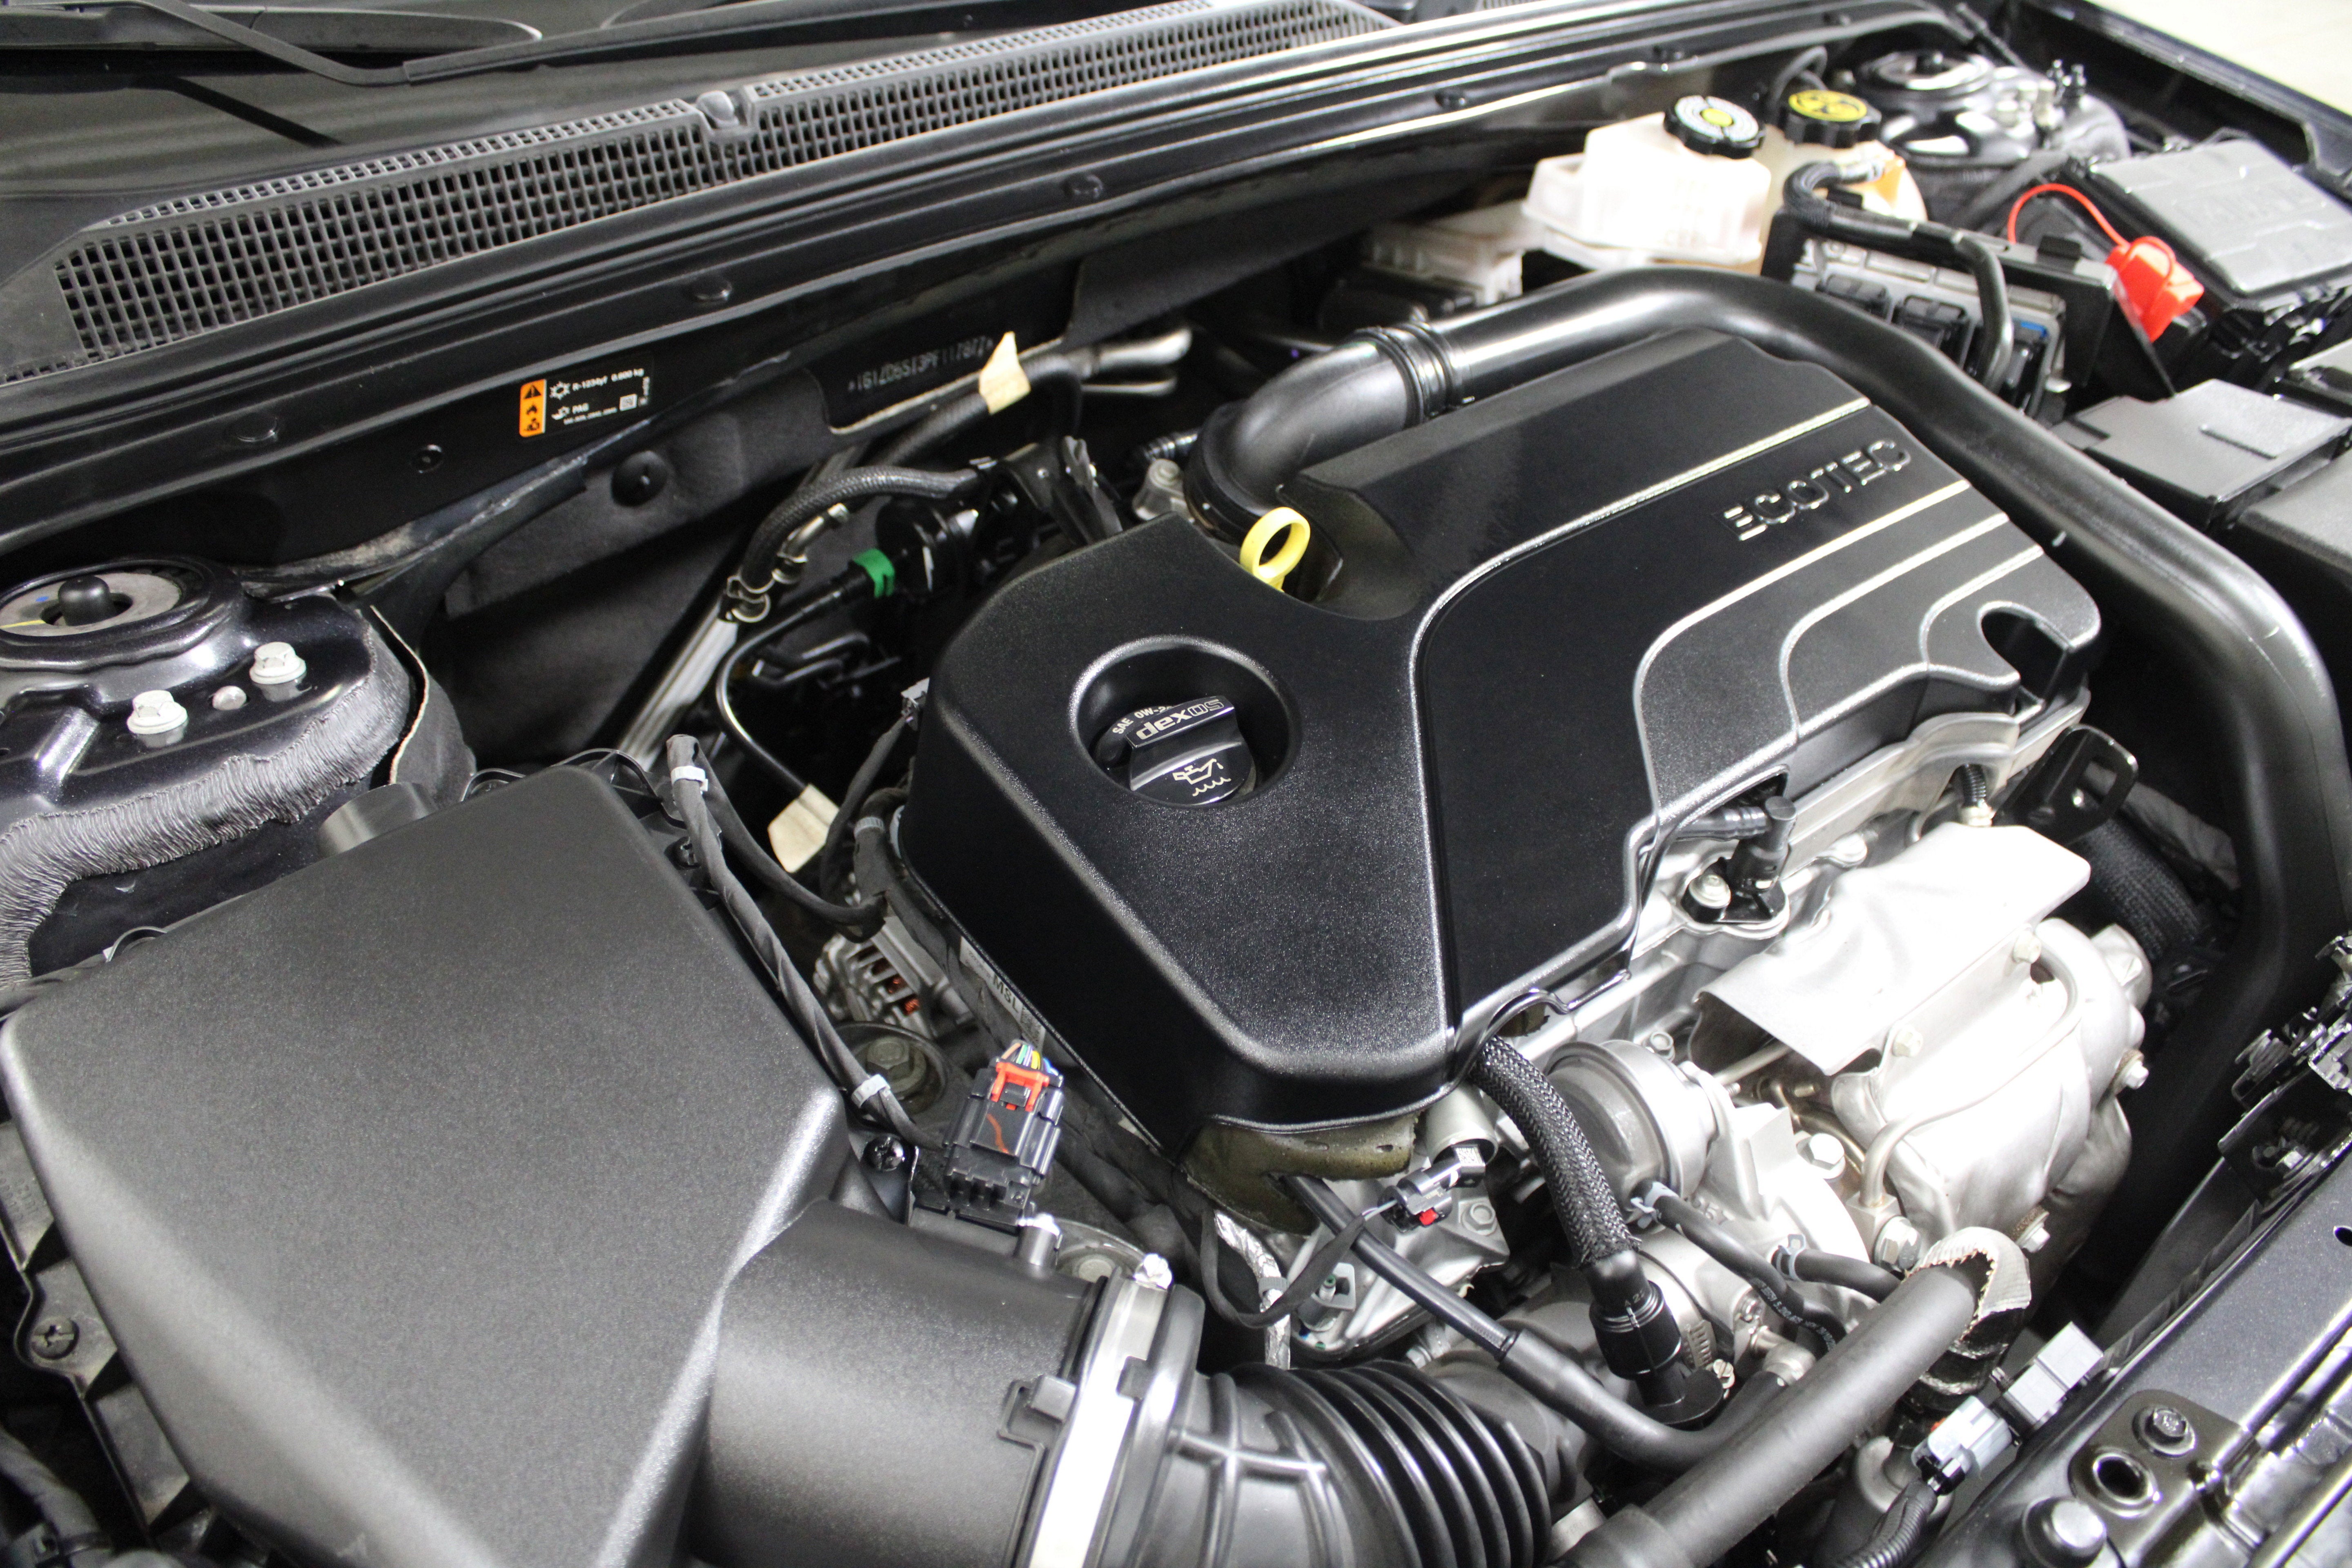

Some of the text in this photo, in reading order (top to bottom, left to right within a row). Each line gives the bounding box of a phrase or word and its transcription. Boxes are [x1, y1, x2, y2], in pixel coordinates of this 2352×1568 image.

[1724, 440, 1911, 541] ECOTEC
[1112, 717, 1134, 734] SAE
[993, 974, 1019, 1013] MSL
